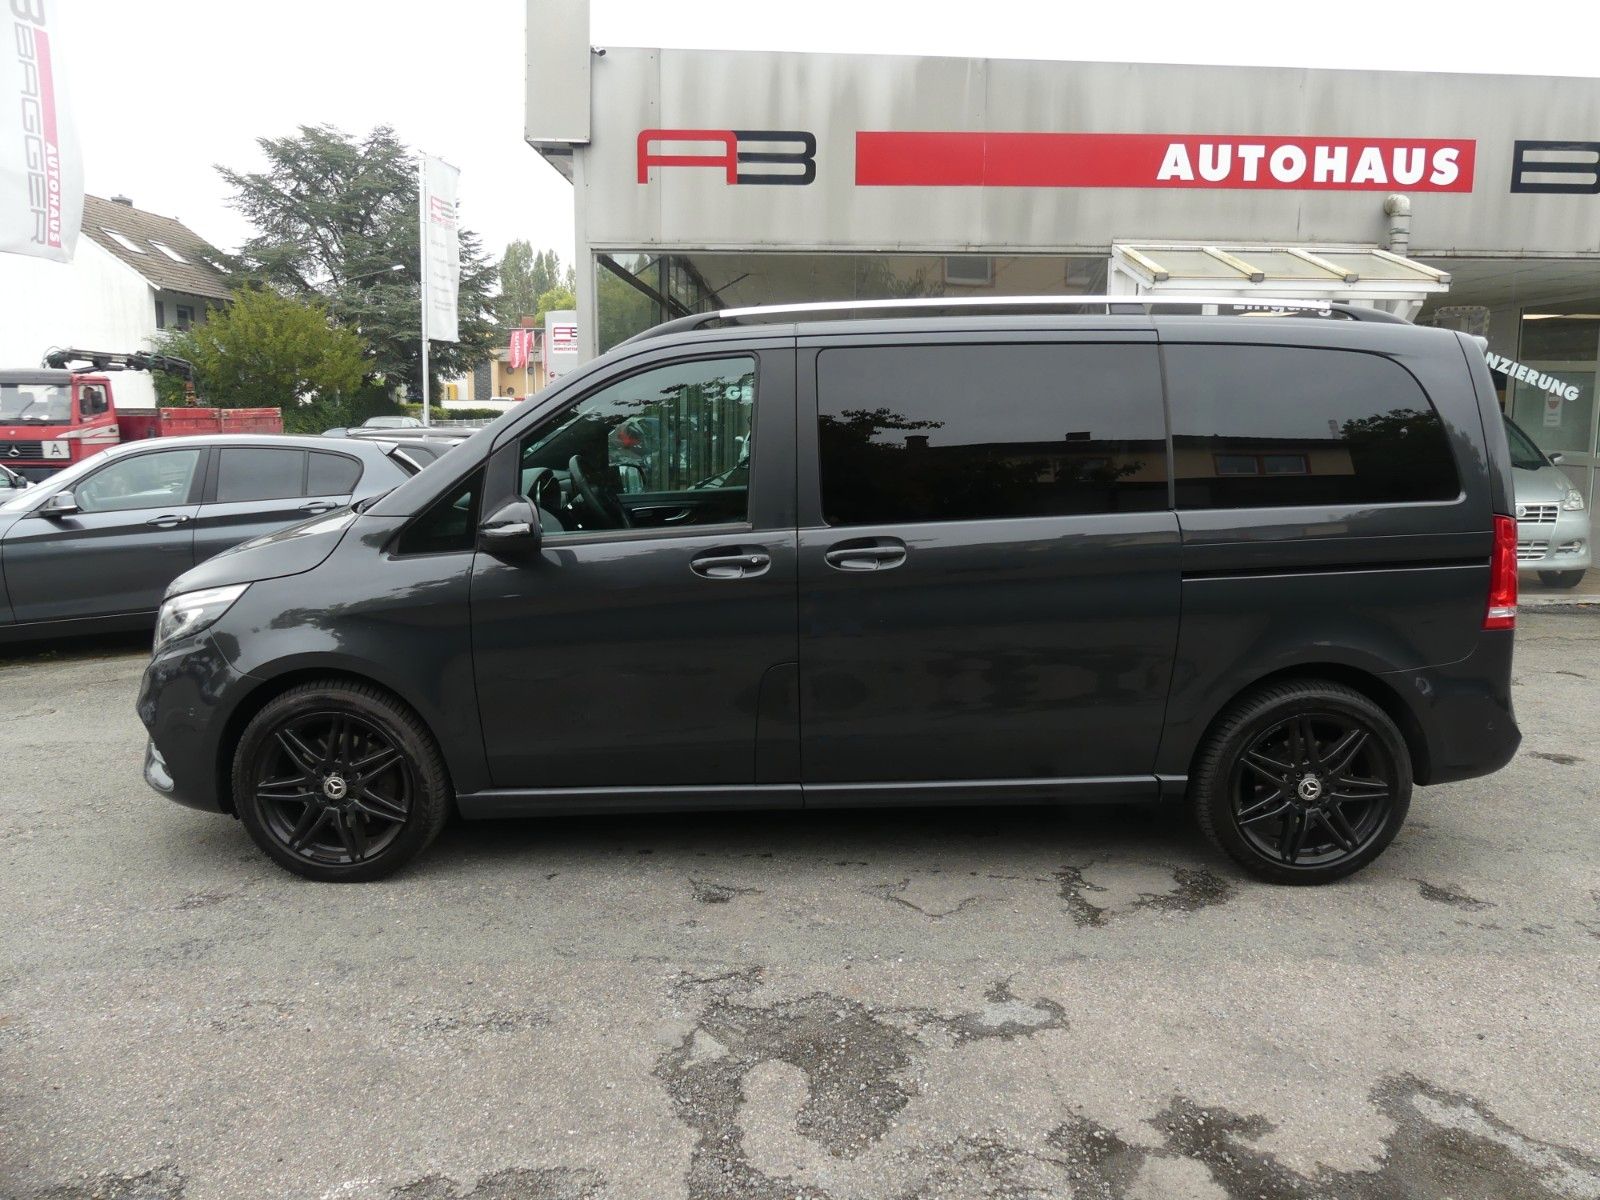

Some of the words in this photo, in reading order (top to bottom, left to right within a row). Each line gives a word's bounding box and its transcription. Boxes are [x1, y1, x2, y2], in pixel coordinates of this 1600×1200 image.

[14, 22, 47, 245] BAGGER
[637, 129, 816, 185] AB
[1156, 143, 1460, 186] AUTOHAUS
[46, 141, 61, 242] AUTOHAUS
[51, 443, 62, 456] A
